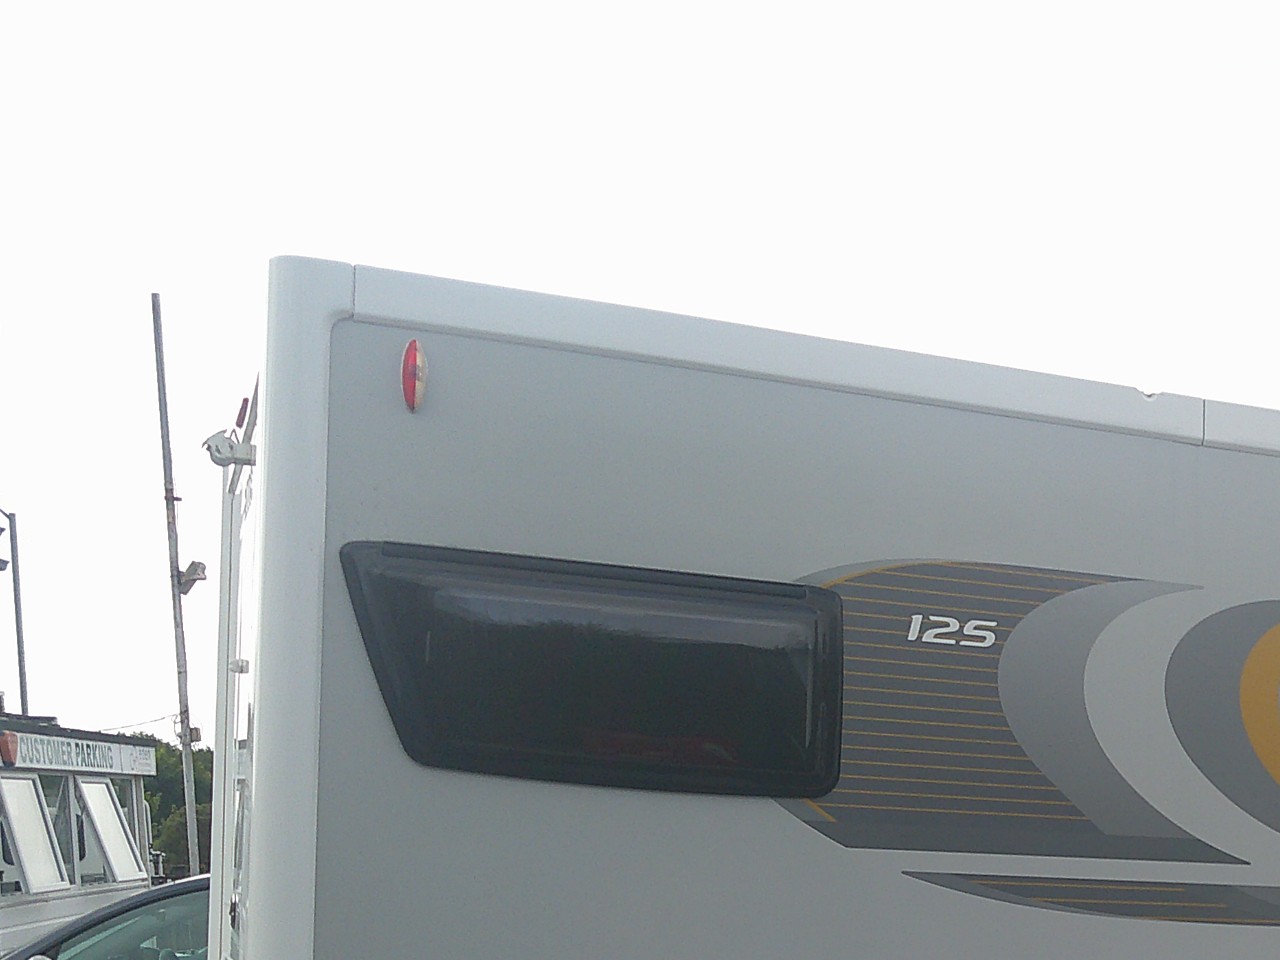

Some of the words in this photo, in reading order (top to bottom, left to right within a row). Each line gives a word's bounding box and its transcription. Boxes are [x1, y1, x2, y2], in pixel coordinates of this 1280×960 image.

[907, 614, 998, 648] 125
[20, 737, 73, 768] CUSTOMER
[74, 742, 114, 770] PARKING
